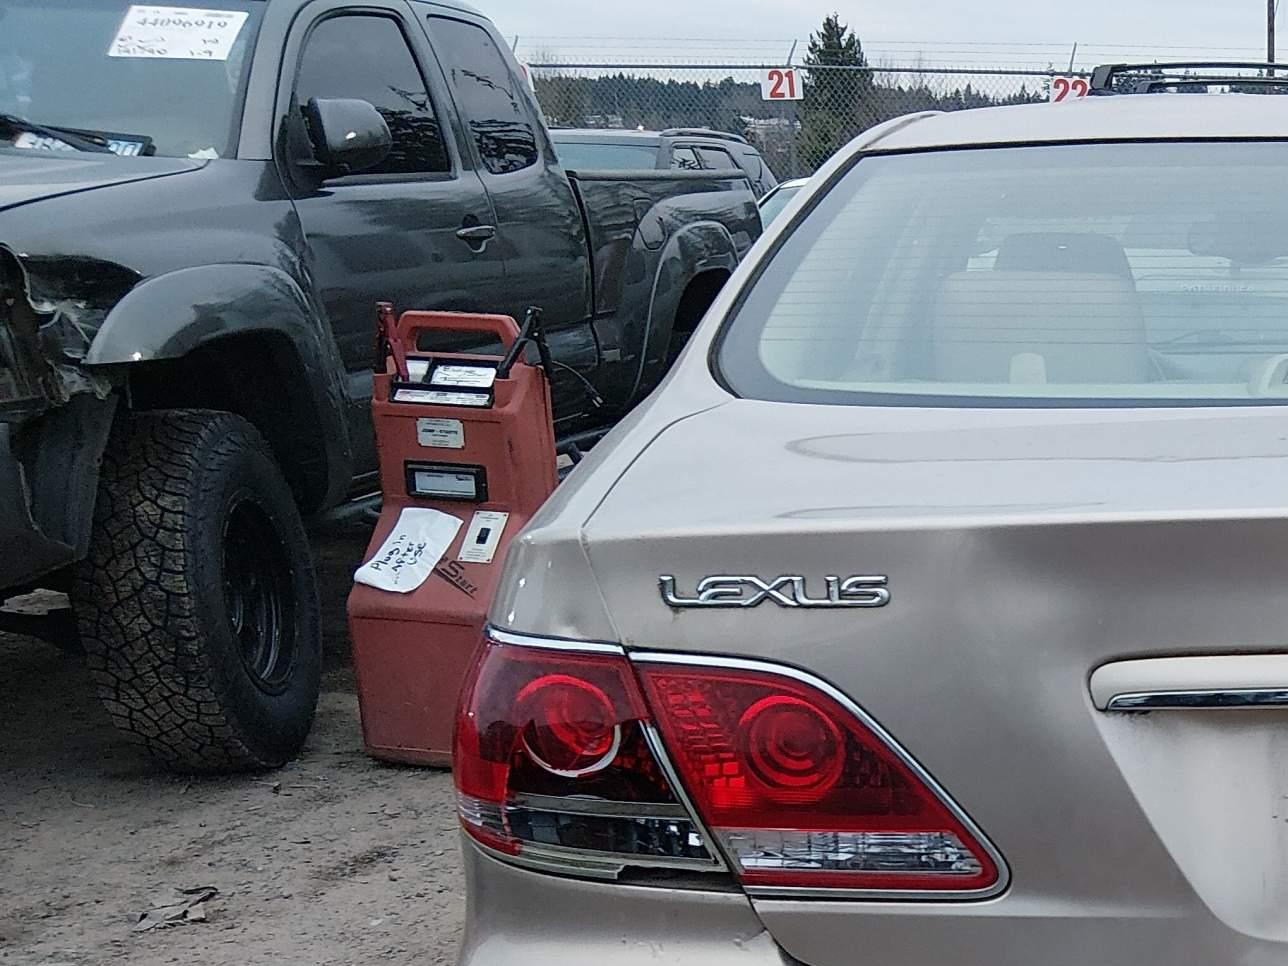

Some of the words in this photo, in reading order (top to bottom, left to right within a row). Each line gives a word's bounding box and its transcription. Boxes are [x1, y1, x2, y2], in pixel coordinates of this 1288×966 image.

[768, 70, 796, 98] 21
[1053, 79, 1088, 103] 22
[658, 575, 890, 607] LEXUS
